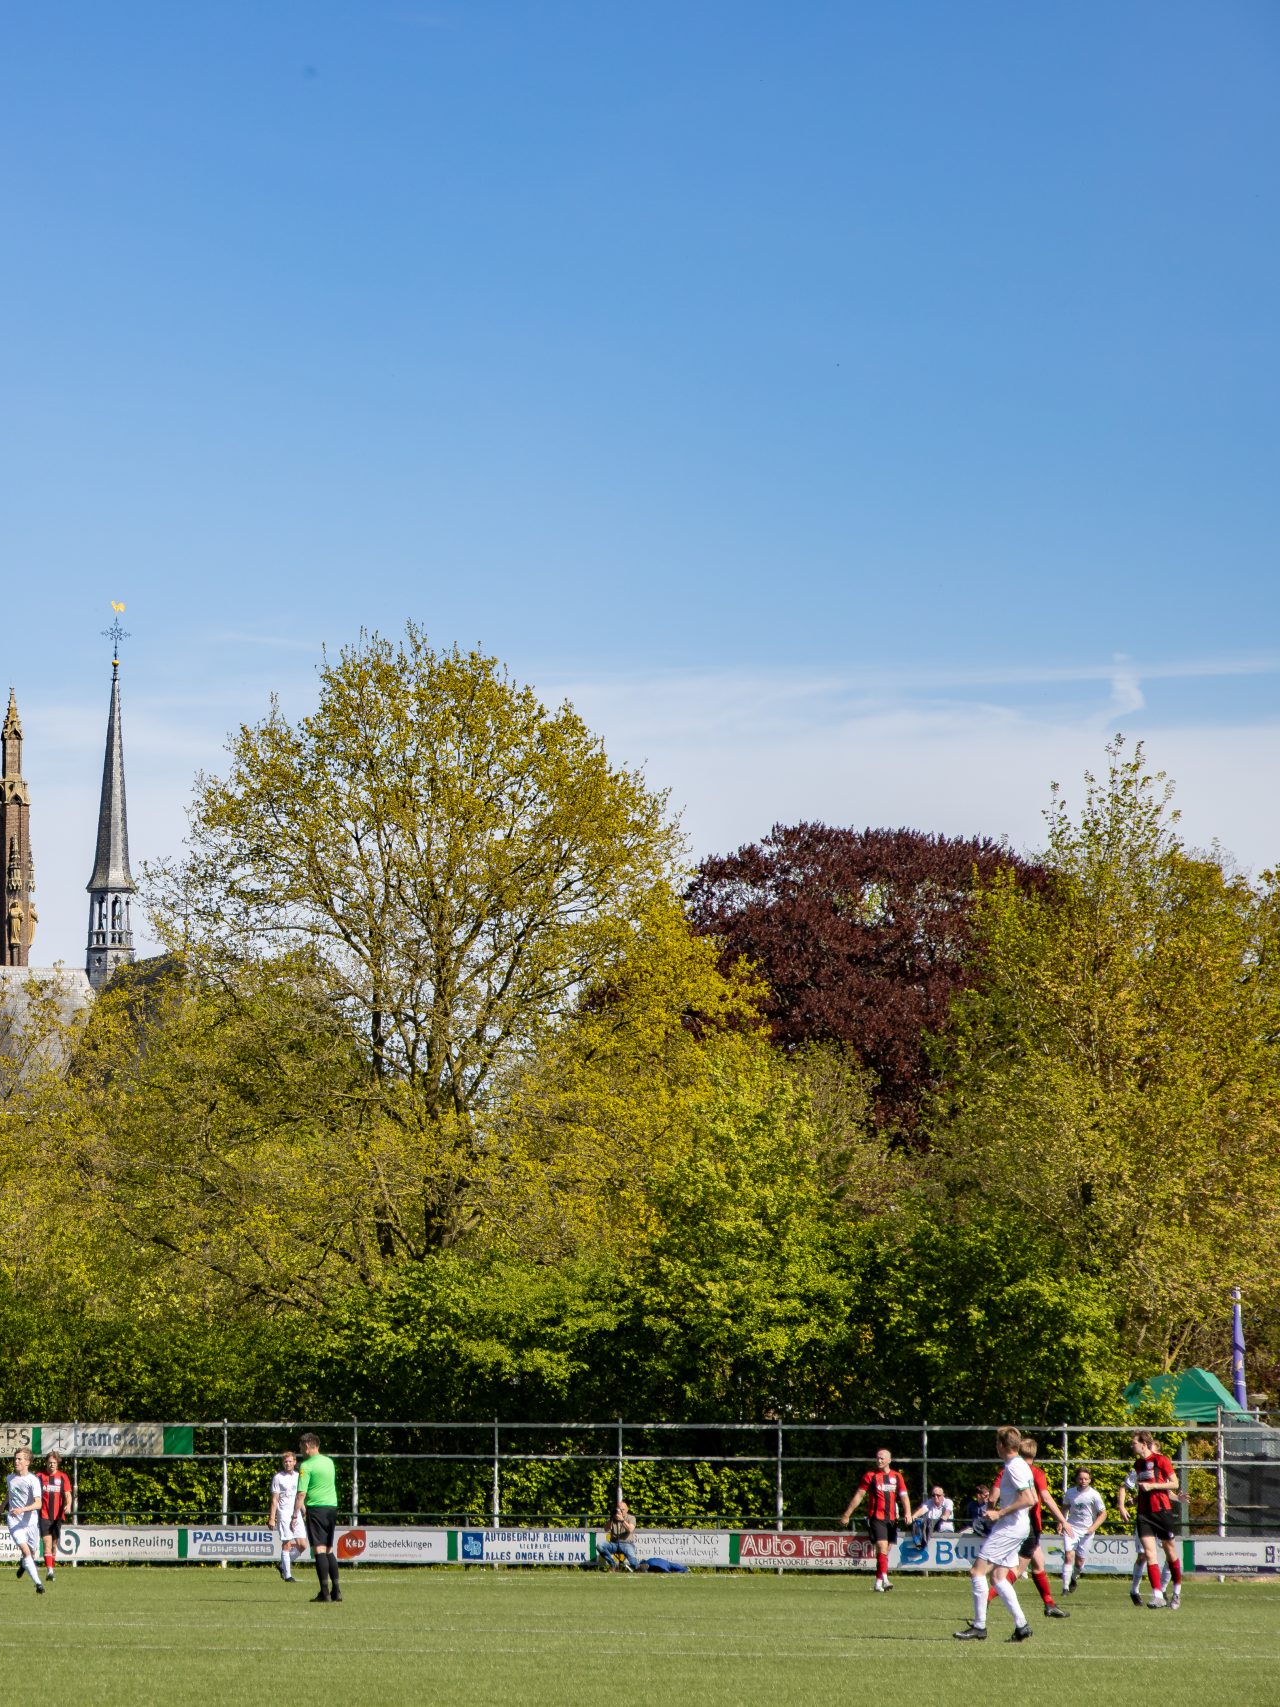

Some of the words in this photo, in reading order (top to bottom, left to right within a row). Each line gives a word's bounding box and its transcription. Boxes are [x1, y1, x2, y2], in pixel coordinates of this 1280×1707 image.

[89, 1536, 174, 1549] BonsenReuling
[192, 1532, 273, 1544] PAASHUIS
[485, 1531, 540, 1542] AUTOBEDRIJF
[543, 1532, 586, 1543] BLEUMINK
[693, 1535, 719, 1545] NKG
[201, 1545, 272, 1553] BEDRIJFSWAGENS
[368, 1540, 432, 1551] dakbedekkingen
[741, 1535, 796, 1556] Auto
[800, 1536, 876, 1559] Tenten
[485, 1552, 511, 1560] ALLES
[515, 1552, 544, 1561] ONDER
[568, 1552, 586, 1561] DAK
